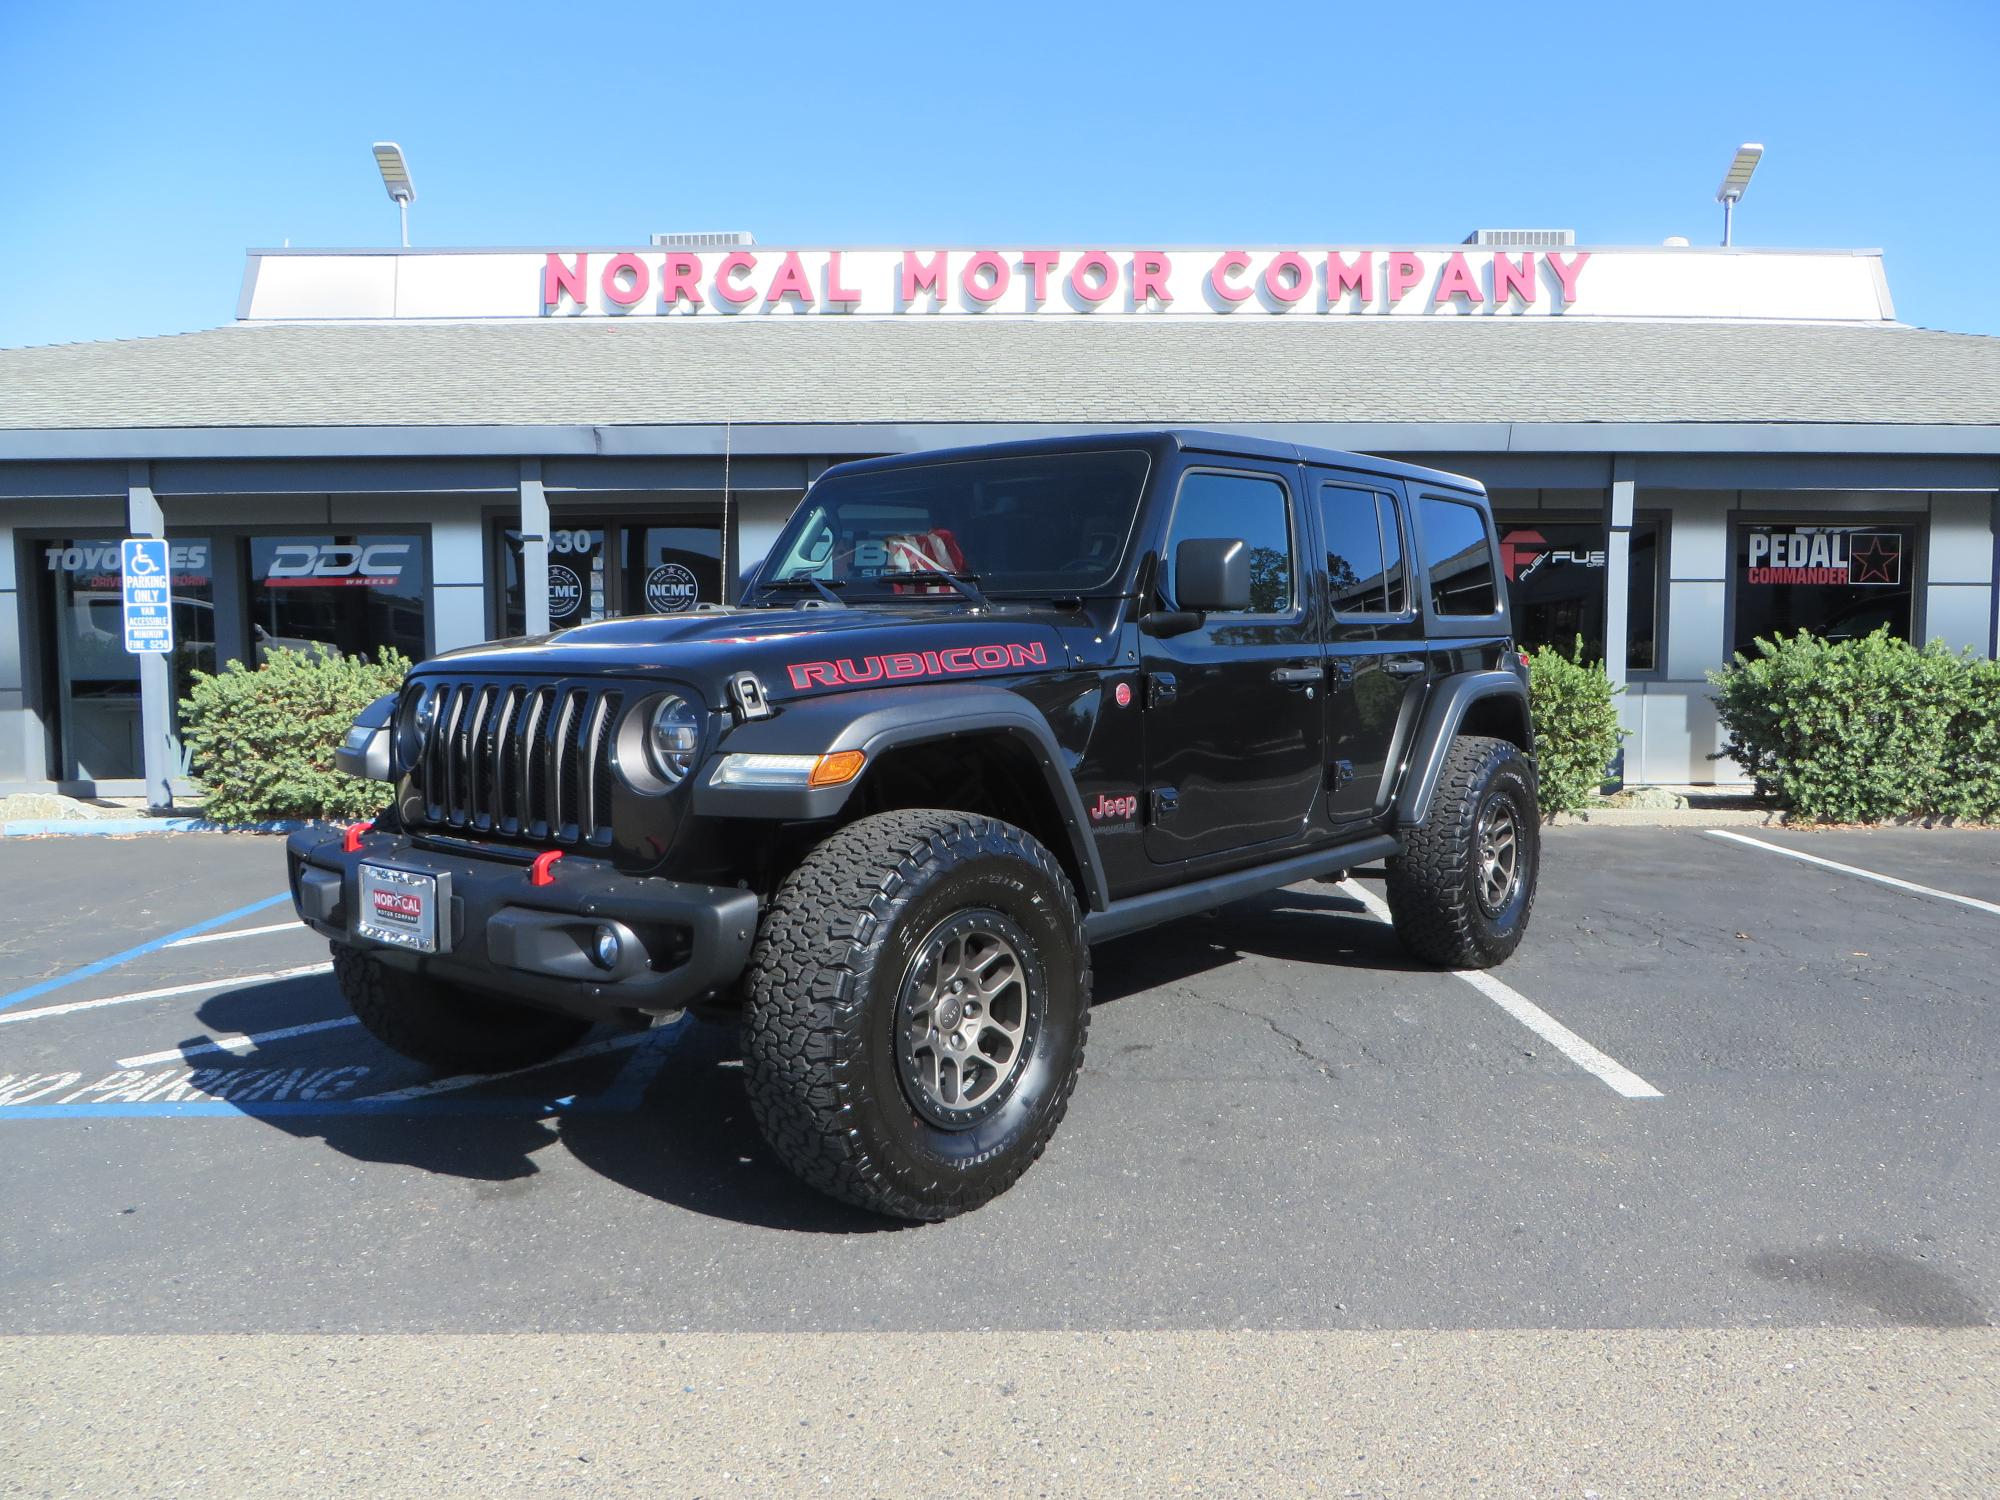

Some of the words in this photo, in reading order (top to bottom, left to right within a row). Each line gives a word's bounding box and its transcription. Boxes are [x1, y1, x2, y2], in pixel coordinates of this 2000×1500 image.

[545, 251, 862, 304] NORCAL
[901, 251, 1174, 302] MOTOR
[1211, 251, 1592, 303] COMPANY
[1552, 551, 1605, 563] FUE
[1749, 533, 1848, 567] PEDAL
[45, 547, 122, 571] TOYO
[267, 544, 410, 577] DDC
[1519, 550, 1550, 581] FUEL
[91, 577, 122, 588] DRIVE
[126, 575, 166, 589] PARKING
[1748, 567, 1848, 585] COMMANDER
[134, 589, 160, 602] ONLY
[650, 584, 694, 596] NCMC
[140, 606, 155, 616] VAN
[129, 616, 167, 626] ACCESSIBLE
[133, 629, 164, 639] MINIMUM
[129, 639, 145, 649] FINE
[149, 639, 169, 649] $250
[787, 642, 1047, 690] RUBICON
[1091, 794, 1138, 820] Jeep
[374, 892, 394, 907] NOR
[402, 898, 420, 912] CAL
[377, 909, 394, 917] MOTOR
[394, 912, 418, 922] COMPANY
[56, 1066, 370, 1104] PARKING
